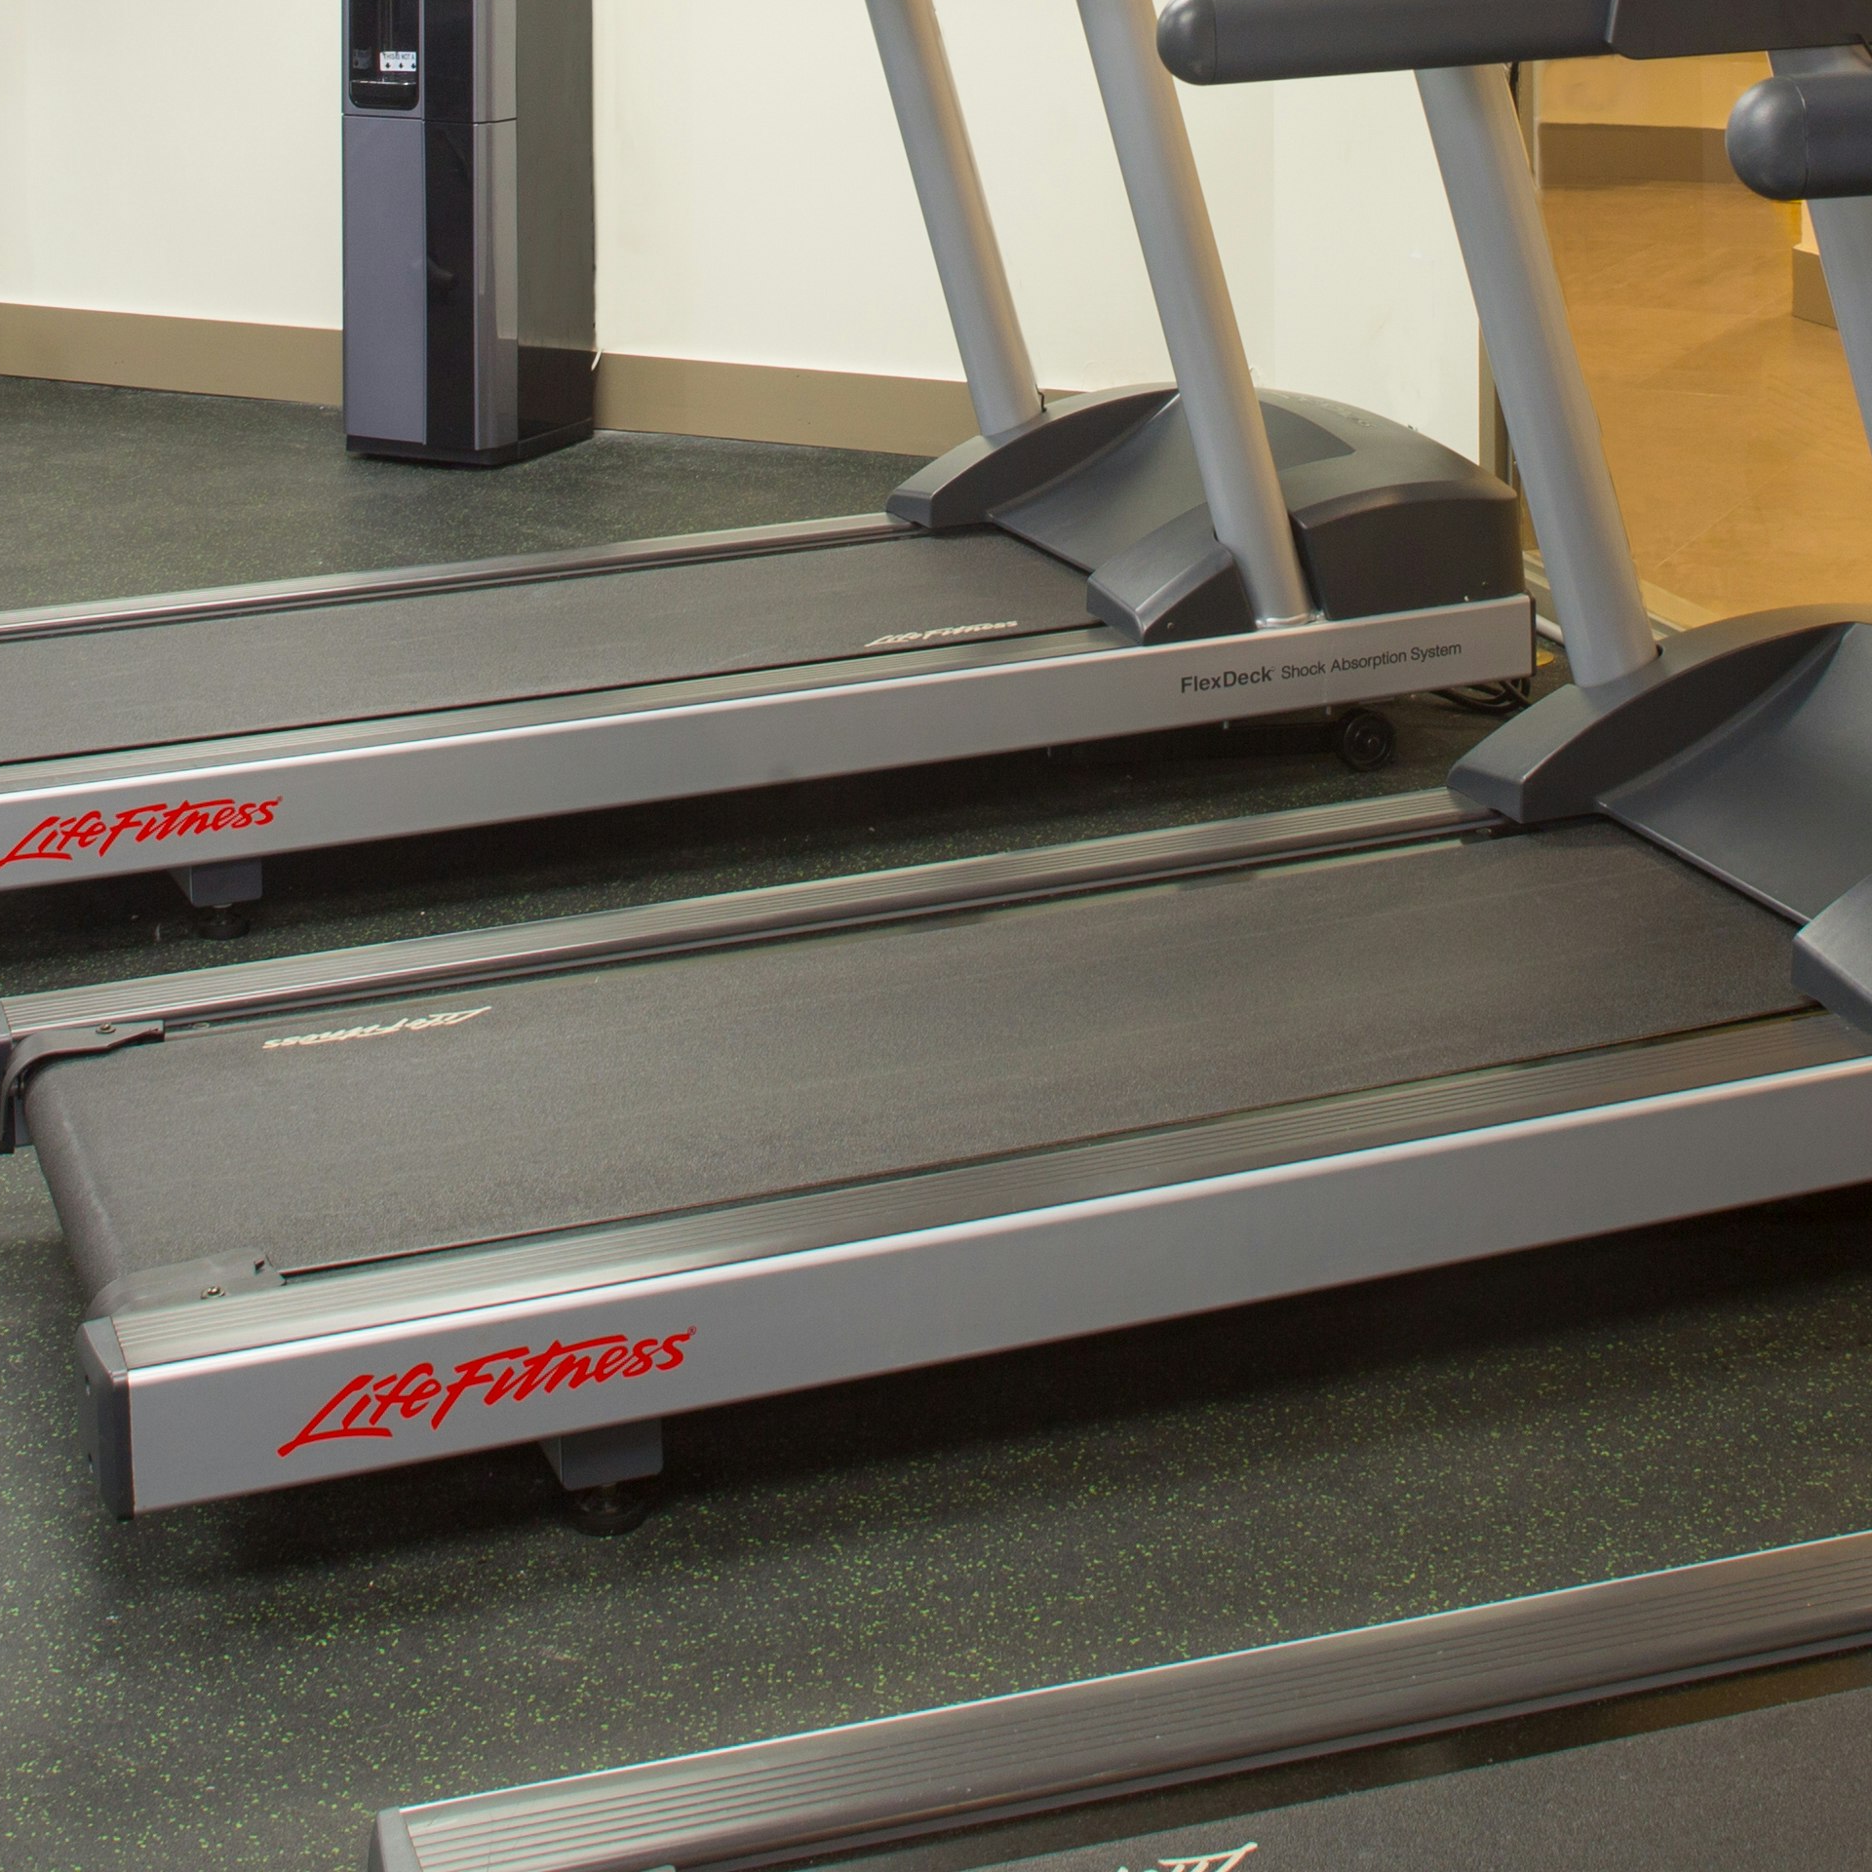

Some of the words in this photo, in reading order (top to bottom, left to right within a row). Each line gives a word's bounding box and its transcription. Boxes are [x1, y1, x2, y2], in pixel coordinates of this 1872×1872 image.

[1181, 666, 1272, 693] FlexDeck
[1281, 661, 1326, 679] Shock
[1330, 650, 1407, 673] Absorption
[1410, 643, 1462, 666] System
